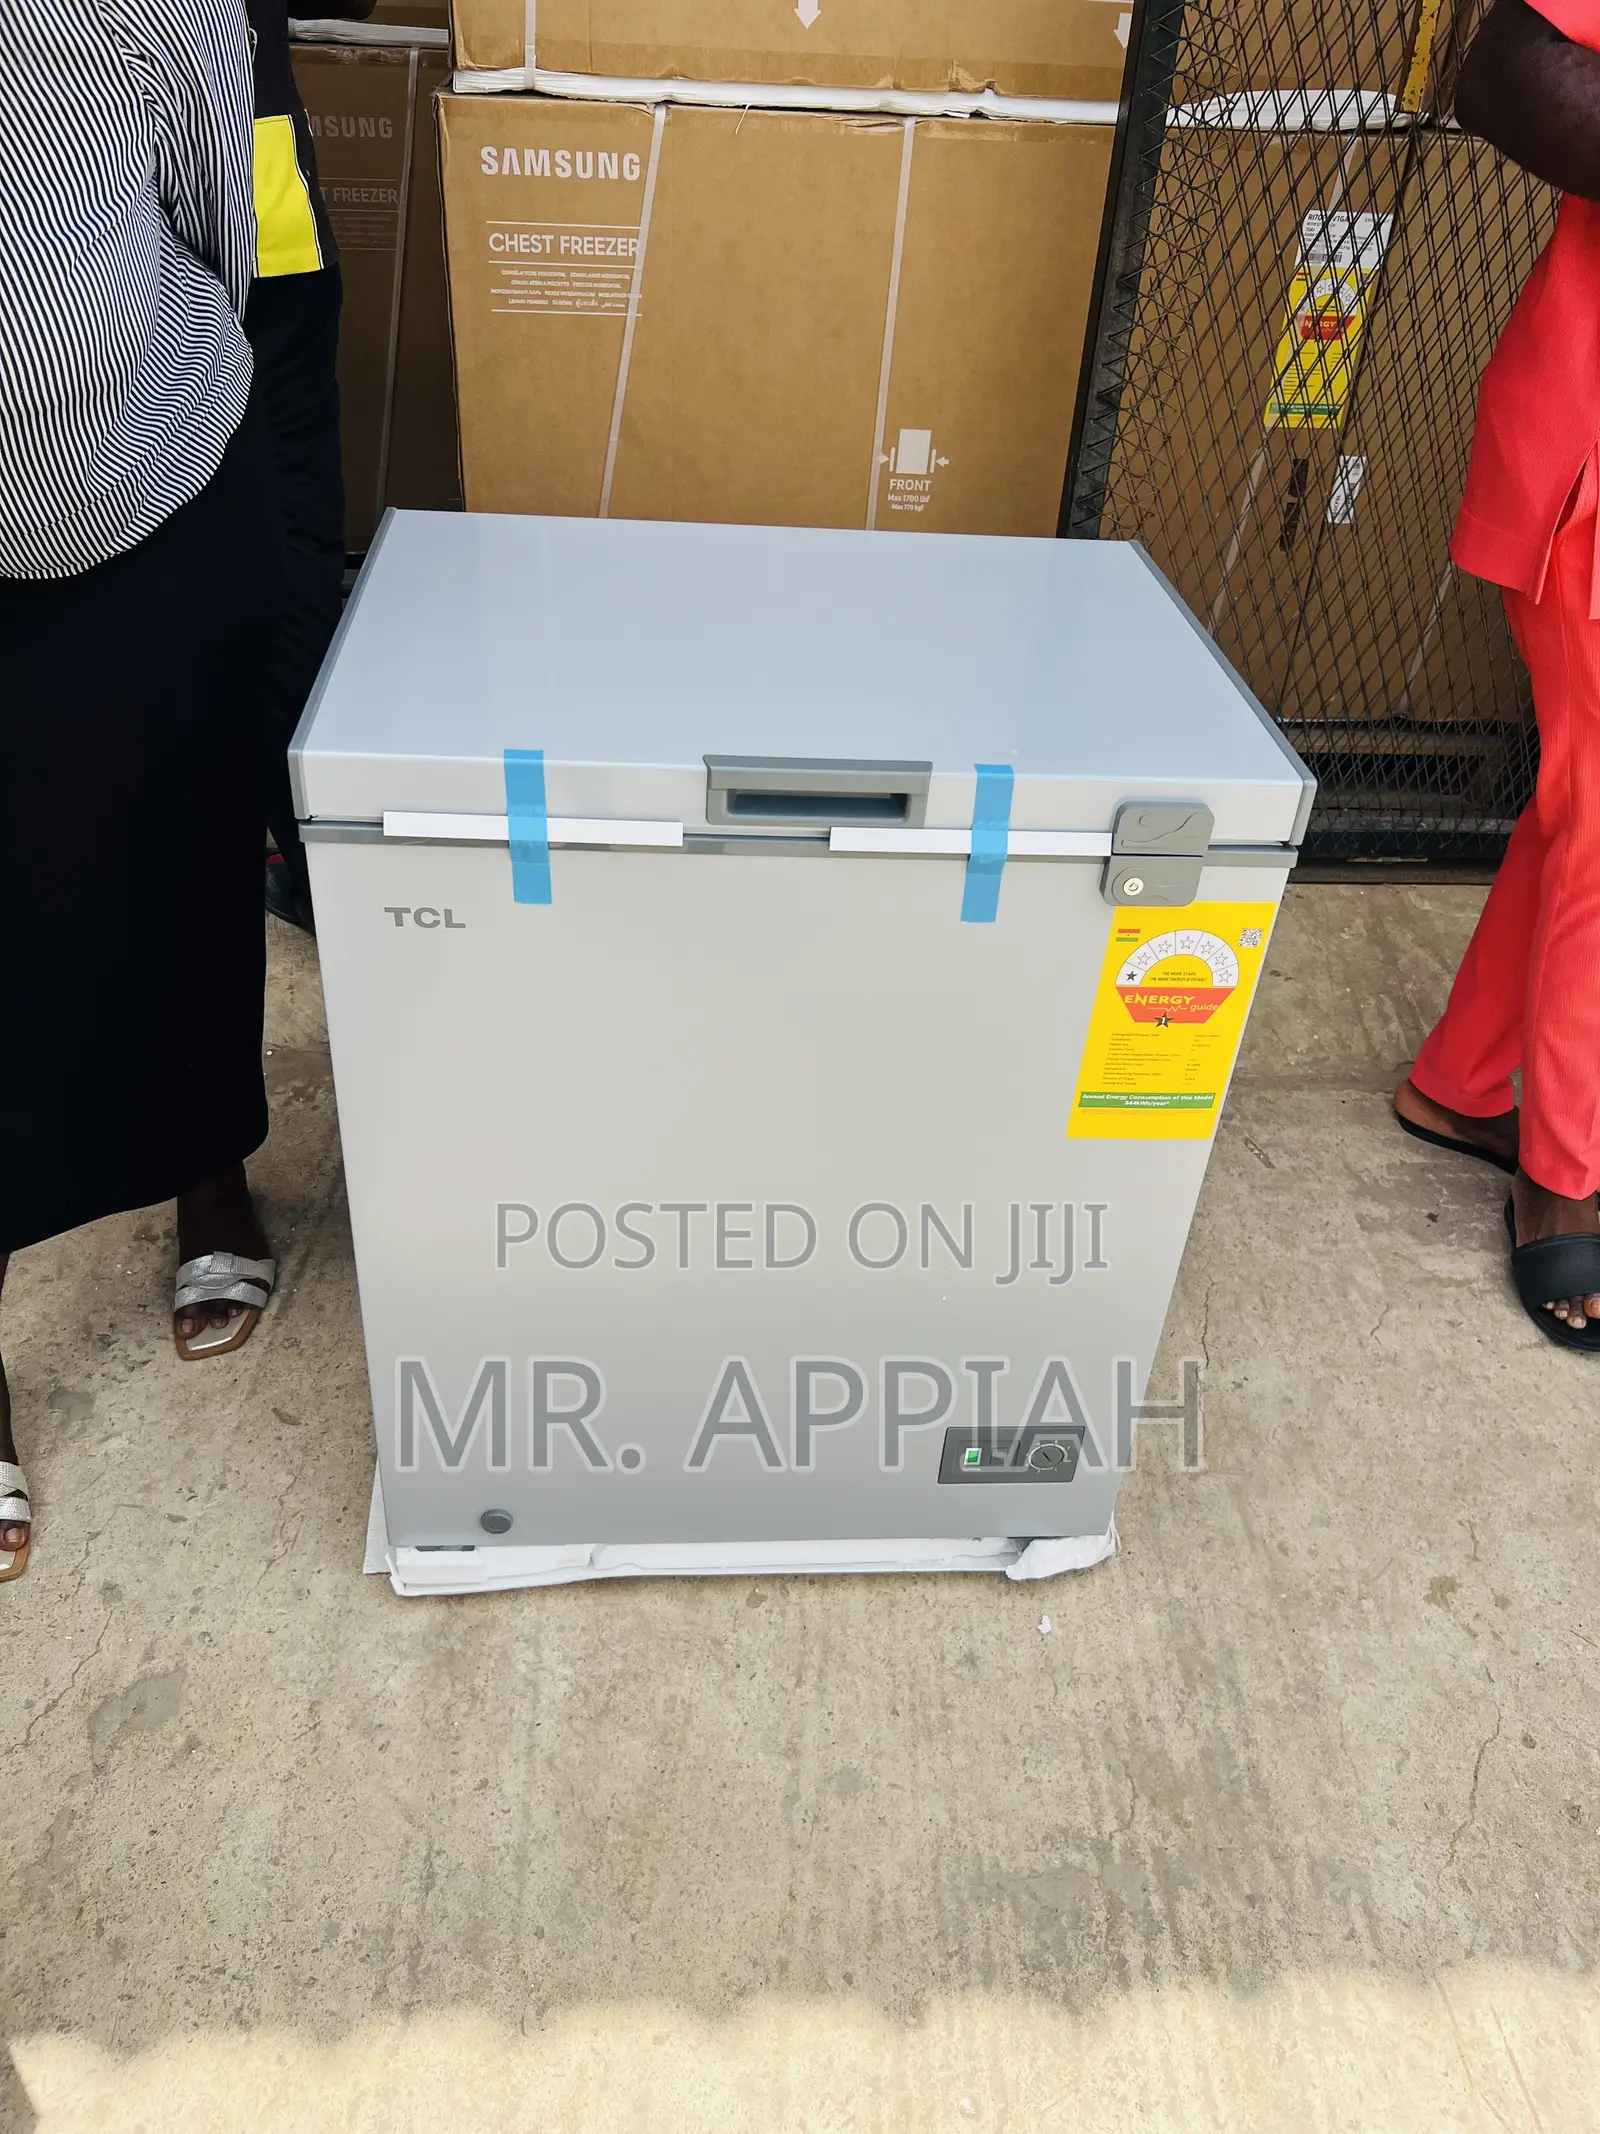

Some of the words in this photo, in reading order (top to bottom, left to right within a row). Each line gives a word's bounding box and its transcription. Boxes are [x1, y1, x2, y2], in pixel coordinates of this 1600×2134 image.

[310, 115, 394, 140] MSUNG
[480, 145, 641, 181] SAMSUNG
[333, 187, 399, 204] FREEZER
[488, 232, 555, 254] CHEST
[559, 235, 640, 257] FREEZER
[889, 479, 932, 492] FRONT
[887, 493, 902, 502] Max
[903, 494, 919, 503] 1700
[383, 906, 467, 929] TCL
[1124, 992, 1197, 1007] ENERGY
[1189, 1003, 1220, 1013] guide
